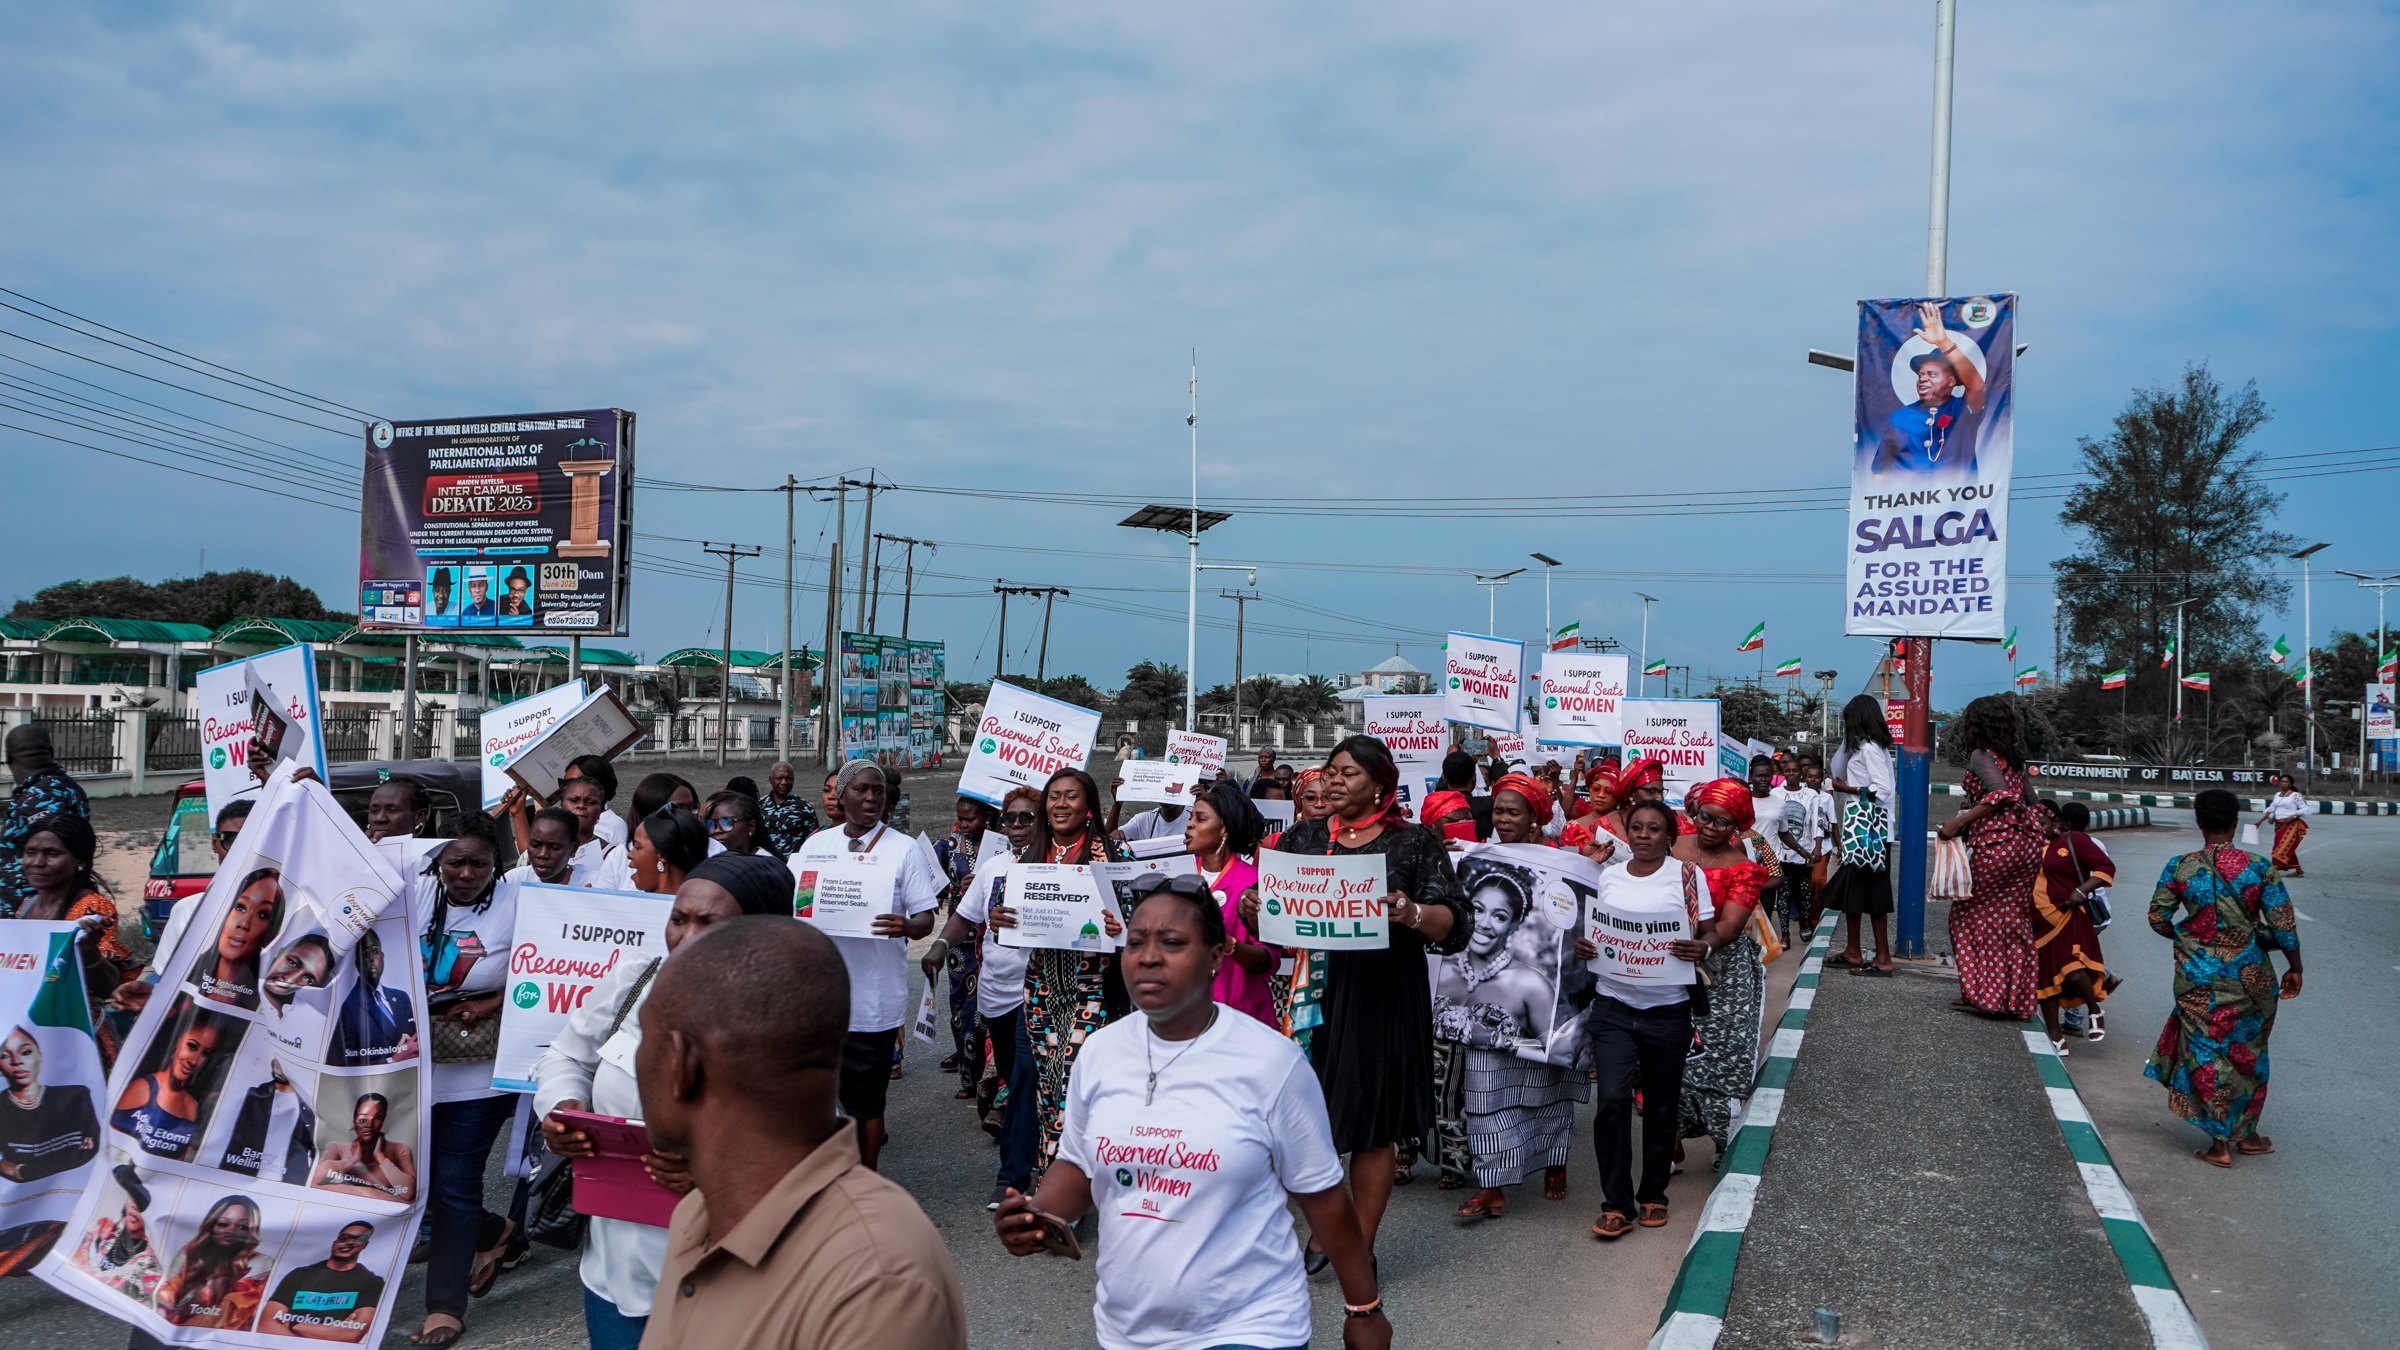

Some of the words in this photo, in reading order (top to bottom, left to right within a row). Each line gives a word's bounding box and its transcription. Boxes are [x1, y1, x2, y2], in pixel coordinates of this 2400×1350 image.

[396, 427, 414, 437] OFFICE
[415, 426, 423, 436] OF
[424, 426, 435, 436] THE
[435, 424, 460, 436] MEMBER
[461, 424, 489, 434] BAYELSA
[490, 422, 516, 434] CENTRAL
[518, 420, 556, 432] SENATORIAL
[557, 418, 586, 430] DISTRICT
[459, 436, 510, 444] COMMEMORATION
[428, 447, 504, 458] INTERNATIONAL
[507, 445, 527, 456] DAY
[528, 444, 543, 454] OF
[430, 456, 538, 470] PARLIAMENTARIANISM
[438, 486, 470, 496] INTER
[473, 484, 523, 495] CAMPUS
[1864, 489, 1941, 510] THANK
[1947, 484, 1994, 502] YOU
[432, 496, 496, 514] DEBATE
[498, 496, 532, 512] 2025
[1854, 508, 1998, 554] SALGA
[544, 564, 576, 580] 30th
[578, 569, 604, 580] 10am
[1865, 561, 1921, 578] FOR
[1929, 558, 1984, 576] THE
[1856, 577, 1990, 598] ASSURED
[582, 592, 605, 600] Medical
[1853, 596, 1993, 617] MANDATE
[1469, 652, 1498, 664] SUPPORT
[1448, 660, 1488, 678] Reserved
[1490, 666, 1517, 684] Seats
[1568, 670, 1602, 678] SUPPORT
[1450, 678, 1460, 688] for
[1462, 678, 1509, 700] WOMEN
[1543, 680, 1590, 694] Reserved
[1594, 682, 1624, 696] Seats
[1546, 698, 1558, 708] for
[1560, 696, 1615, 712] WOMEN
[514, 708, 552, 728] SUPPORT
[1014, 710, 1018, 719] I
[1020, 712, 1062, 732] SUPPORT
[1652, 718, 1687, 727] SUPPORT
[203, 717, 256, 744] Reserve
[1368, 720, 1413, 735] Reserved
[1416, 720, 1446, 734] Seats
[485, 721, 542, 754] Reserved
[981, 738, 995, 752] for
[982, 716, 1045, 748] Reserved
[1045, 736, 1084, 762] Seats
[1183, 736, 1218, 746] SUPPORT
[1385, 736, 1438, 750] WOMEN
[1624, 729, 1676, 746] Reserved
[1680, 731, 1714, 747] Seats
[1168, 743, 1204, 757] Reserved
[1204, 748, 1224, 760] Seats
[1010, 770, 1028, 781] BILL
[2040, 765, 2130, 778] GOVERNMENT
[2142, 769, 2160, 780] OF
[2172, 770, 2224, 782] BAYELSA
[2232, 772, 2264, 782] STATE
[1297, 866, 1300, 874] I
[1301, 866, 1336, 876] SUPPORT
[844, 886, 862, 894] Laws,
[1025, 882, 1060, 892] SEATS
[1263, 873, 1328, 898] Reserved
[1333, 876, 1380, 899] Seat
[820, 898, 848, 906] Reserved
[1024, 892, 1090, 902] RESERVED?
[1282, 896, 1382, 918] WOMEN
[1592, 907, 1610, 926] Ami
[1612, 916, 1642, 933] mme
[1646, 920, 1680, 934] yime
[562, 924, 568, 938] I
[572, 924, 644, 946] SUPPORT
[1295, 920, 1378, 938] BILL
[1591, 925, 1642, 950] Reserved
[510, 942, 620, 978] Reserved
[1618, 950, 1666, 966] Women
[202, 982, 236, 998] Ogwuche
[216, 979, 253, 995] Igbinedion
[516, 983, 539, 1006] for
[359, 1044, 408, 1057] Okinbaloye
[154, 1128, 192, 1144] Etomi
[1130, 1126, 1134, 1136] I
[1136, 1126, 1182, 1140] SUPPORT
[1096, 1136, 1170, 1166] Reserved
[1168, 1142, 1220, 1172] Seats
[326, 1168, 342, 1180] Ini
[1118, 1170, 1131, 1184] for
[1137, 1168, 1192, 1198] Women
[1142, 1199, 1160, 1212] BILL
[190, 1303, 222, 1316] Toolz
[272, 1310, 320, 1325] Aproko
[323, 1316, 368, 1331] Doctor
